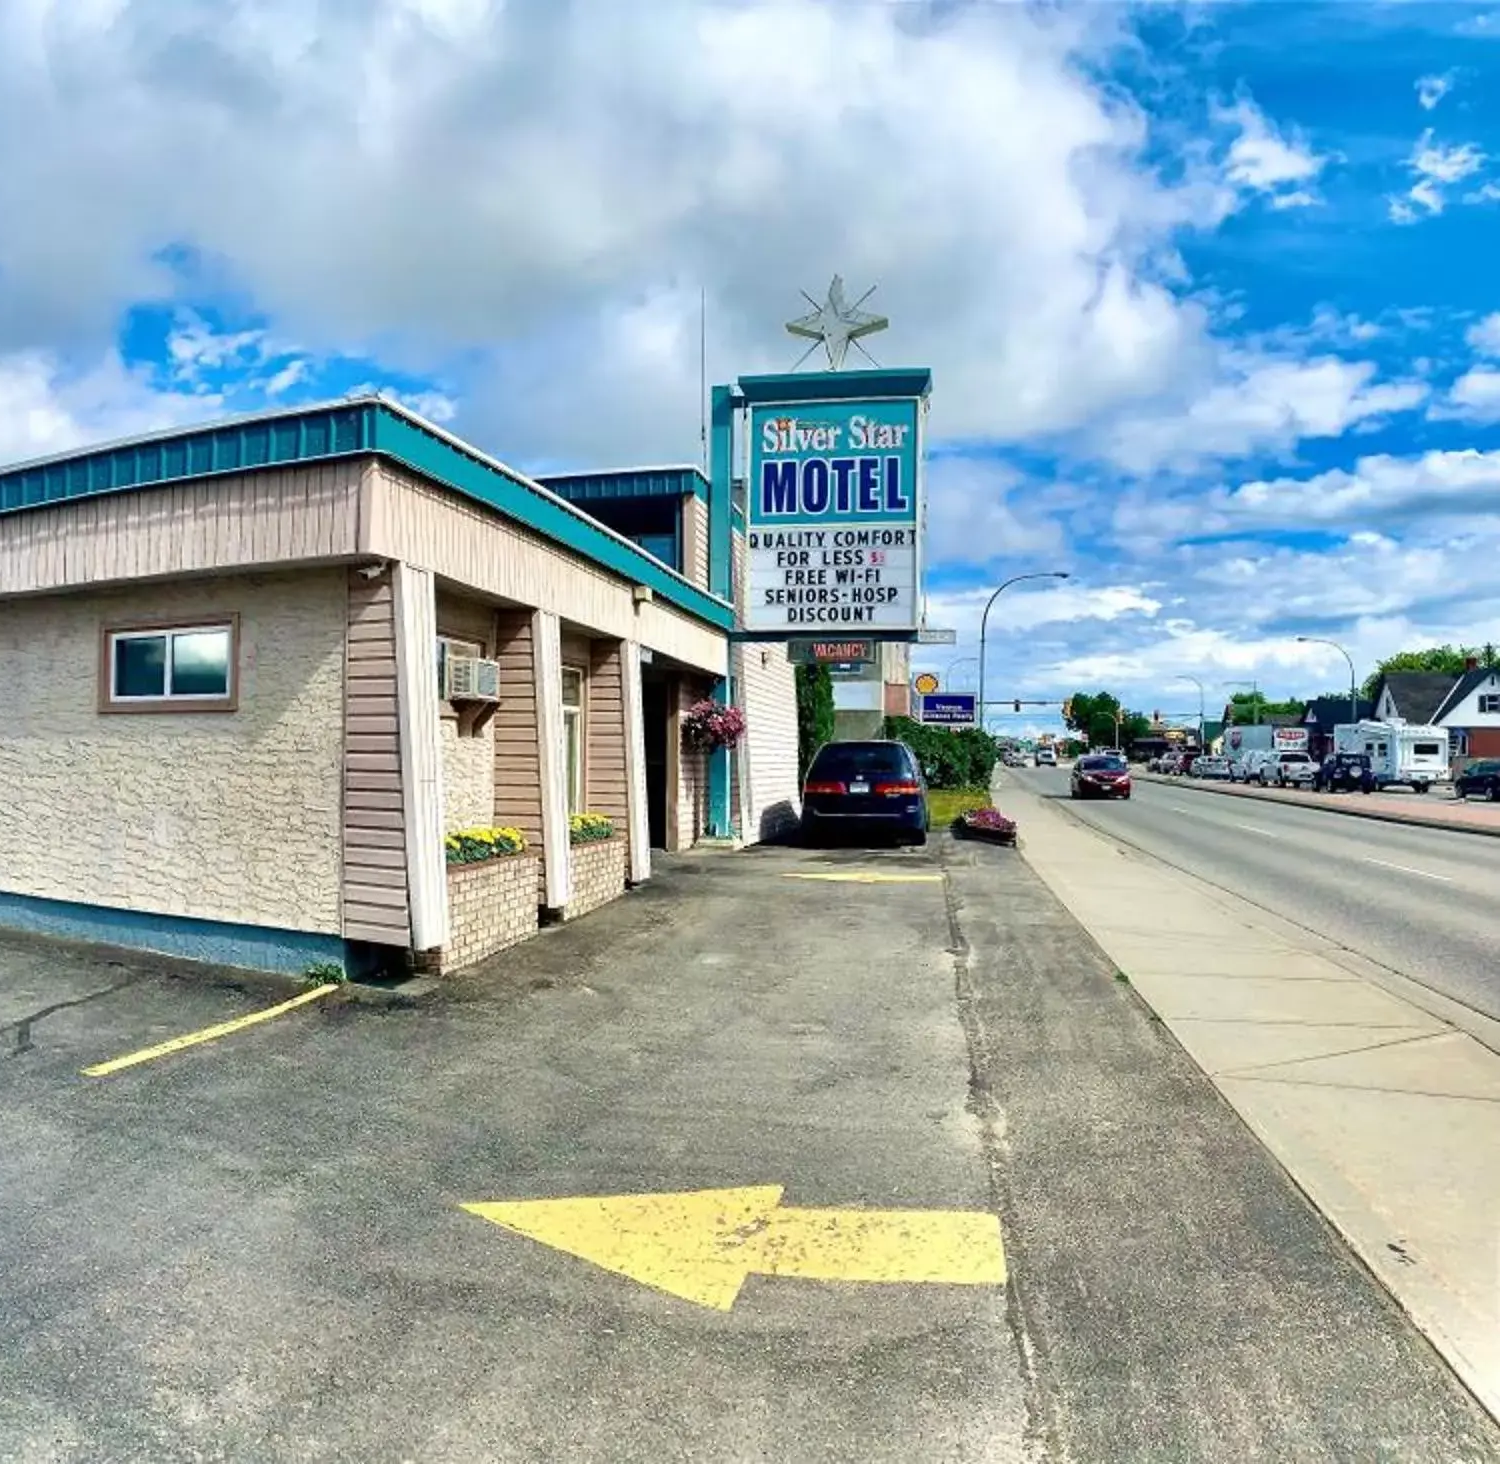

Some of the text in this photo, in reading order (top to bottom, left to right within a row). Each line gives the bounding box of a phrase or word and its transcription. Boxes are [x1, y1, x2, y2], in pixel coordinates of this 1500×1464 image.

[762, 415, 909, 453] Silver Star
[761, 455, 909, 516] MOTEL
[750, 529, 916, 548] QUALITY COMFORT
[777, 551, 809, 566] FOR
[823, 550, 864, 565] LESS
[785, 568, 880, 585] FREE WI-FI
[787, 606, 875, 623] DISCOUNT
[813, 642, 866, 658] VACANCY
